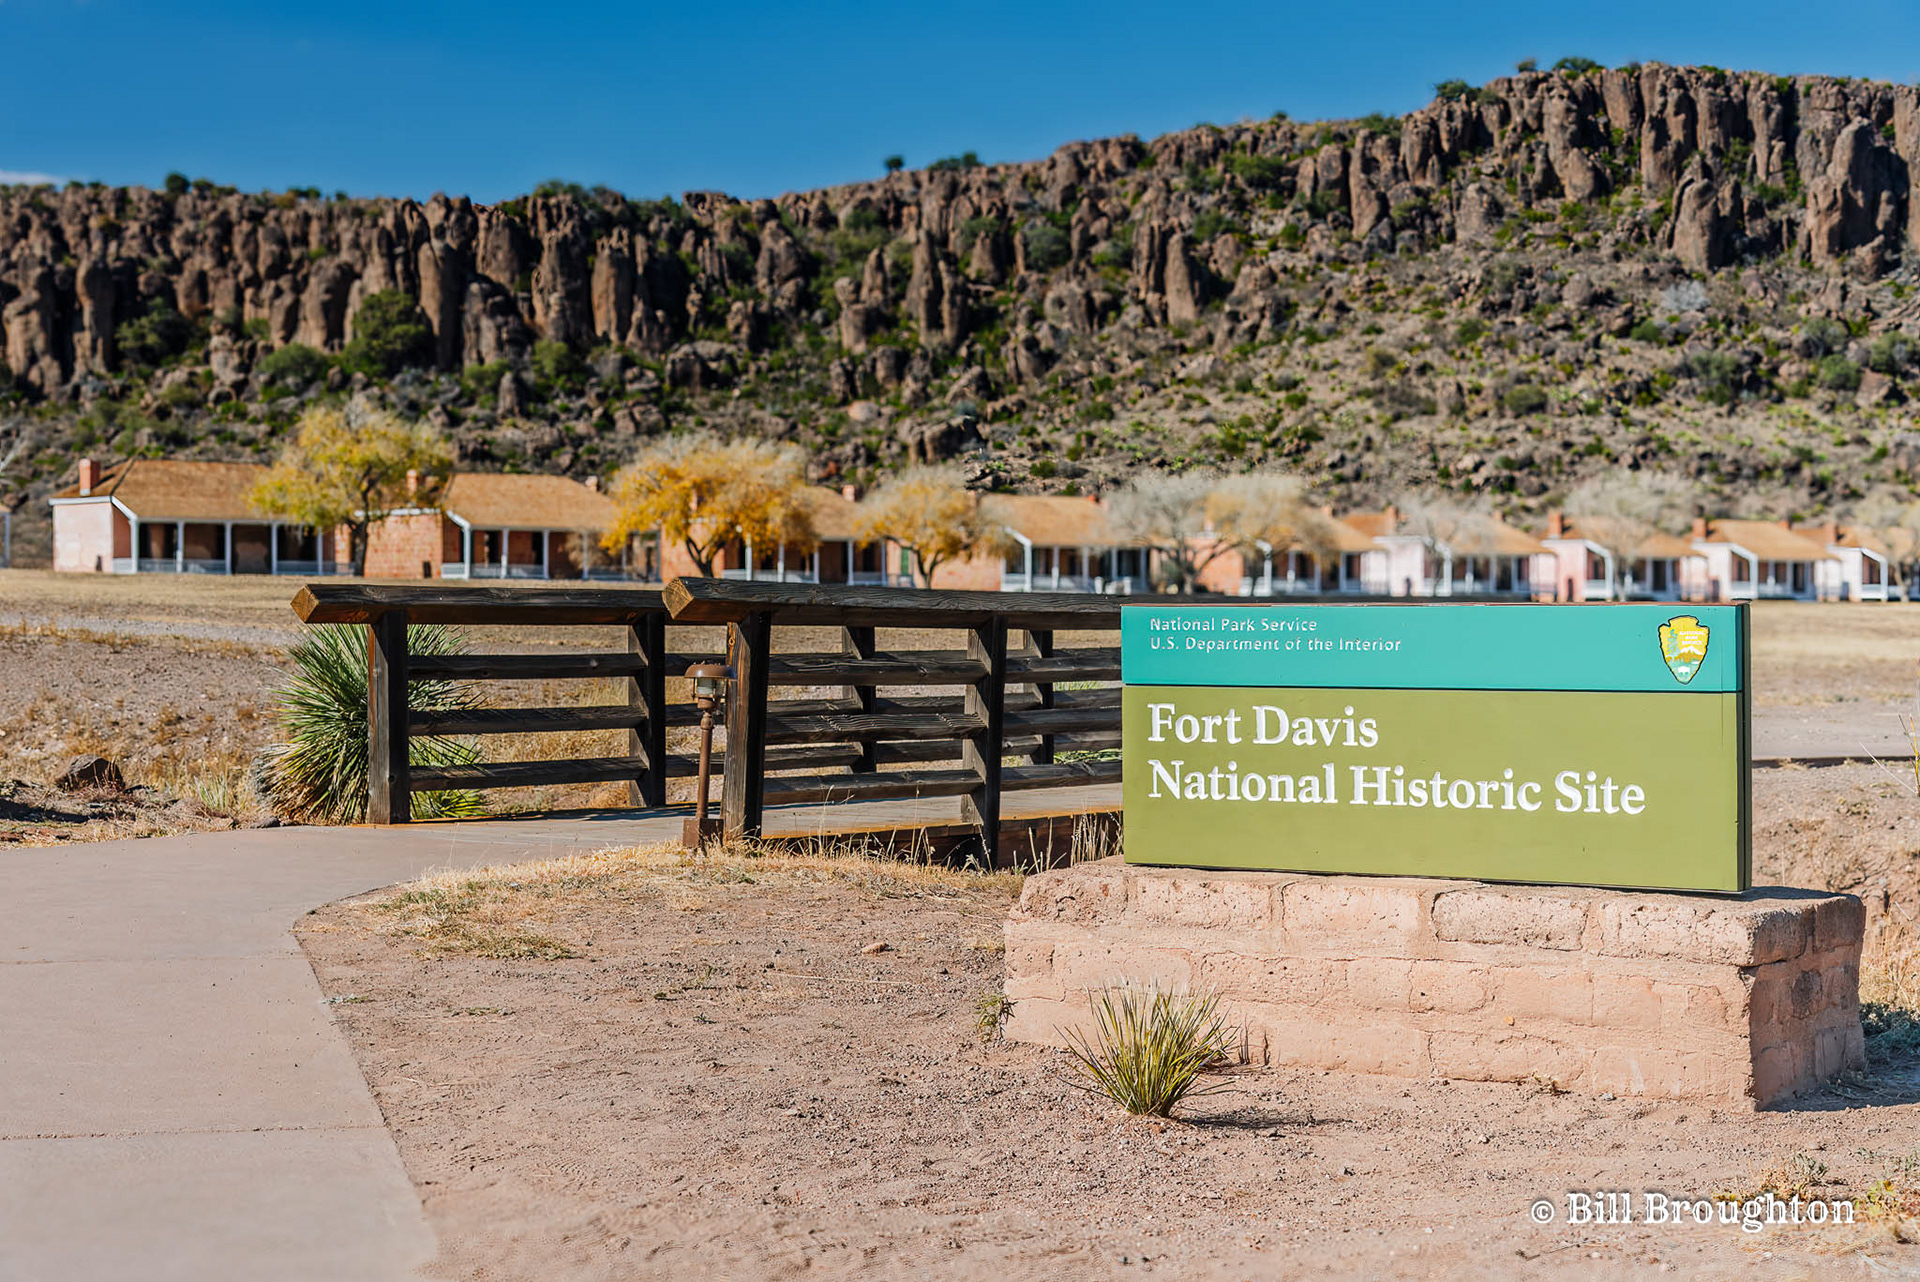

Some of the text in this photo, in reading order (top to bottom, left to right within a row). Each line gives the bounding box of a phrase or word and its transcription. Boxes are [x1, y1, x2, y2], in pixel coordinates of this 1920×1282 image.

[1150, 616, 1318, 632] National Park Service
[1150, 637, 1401, 653] U.S. Department of the Interior
[1147, 703, 1379, 748] Fort Davis
[1147, 760, 1646, 816] National Historic Site
